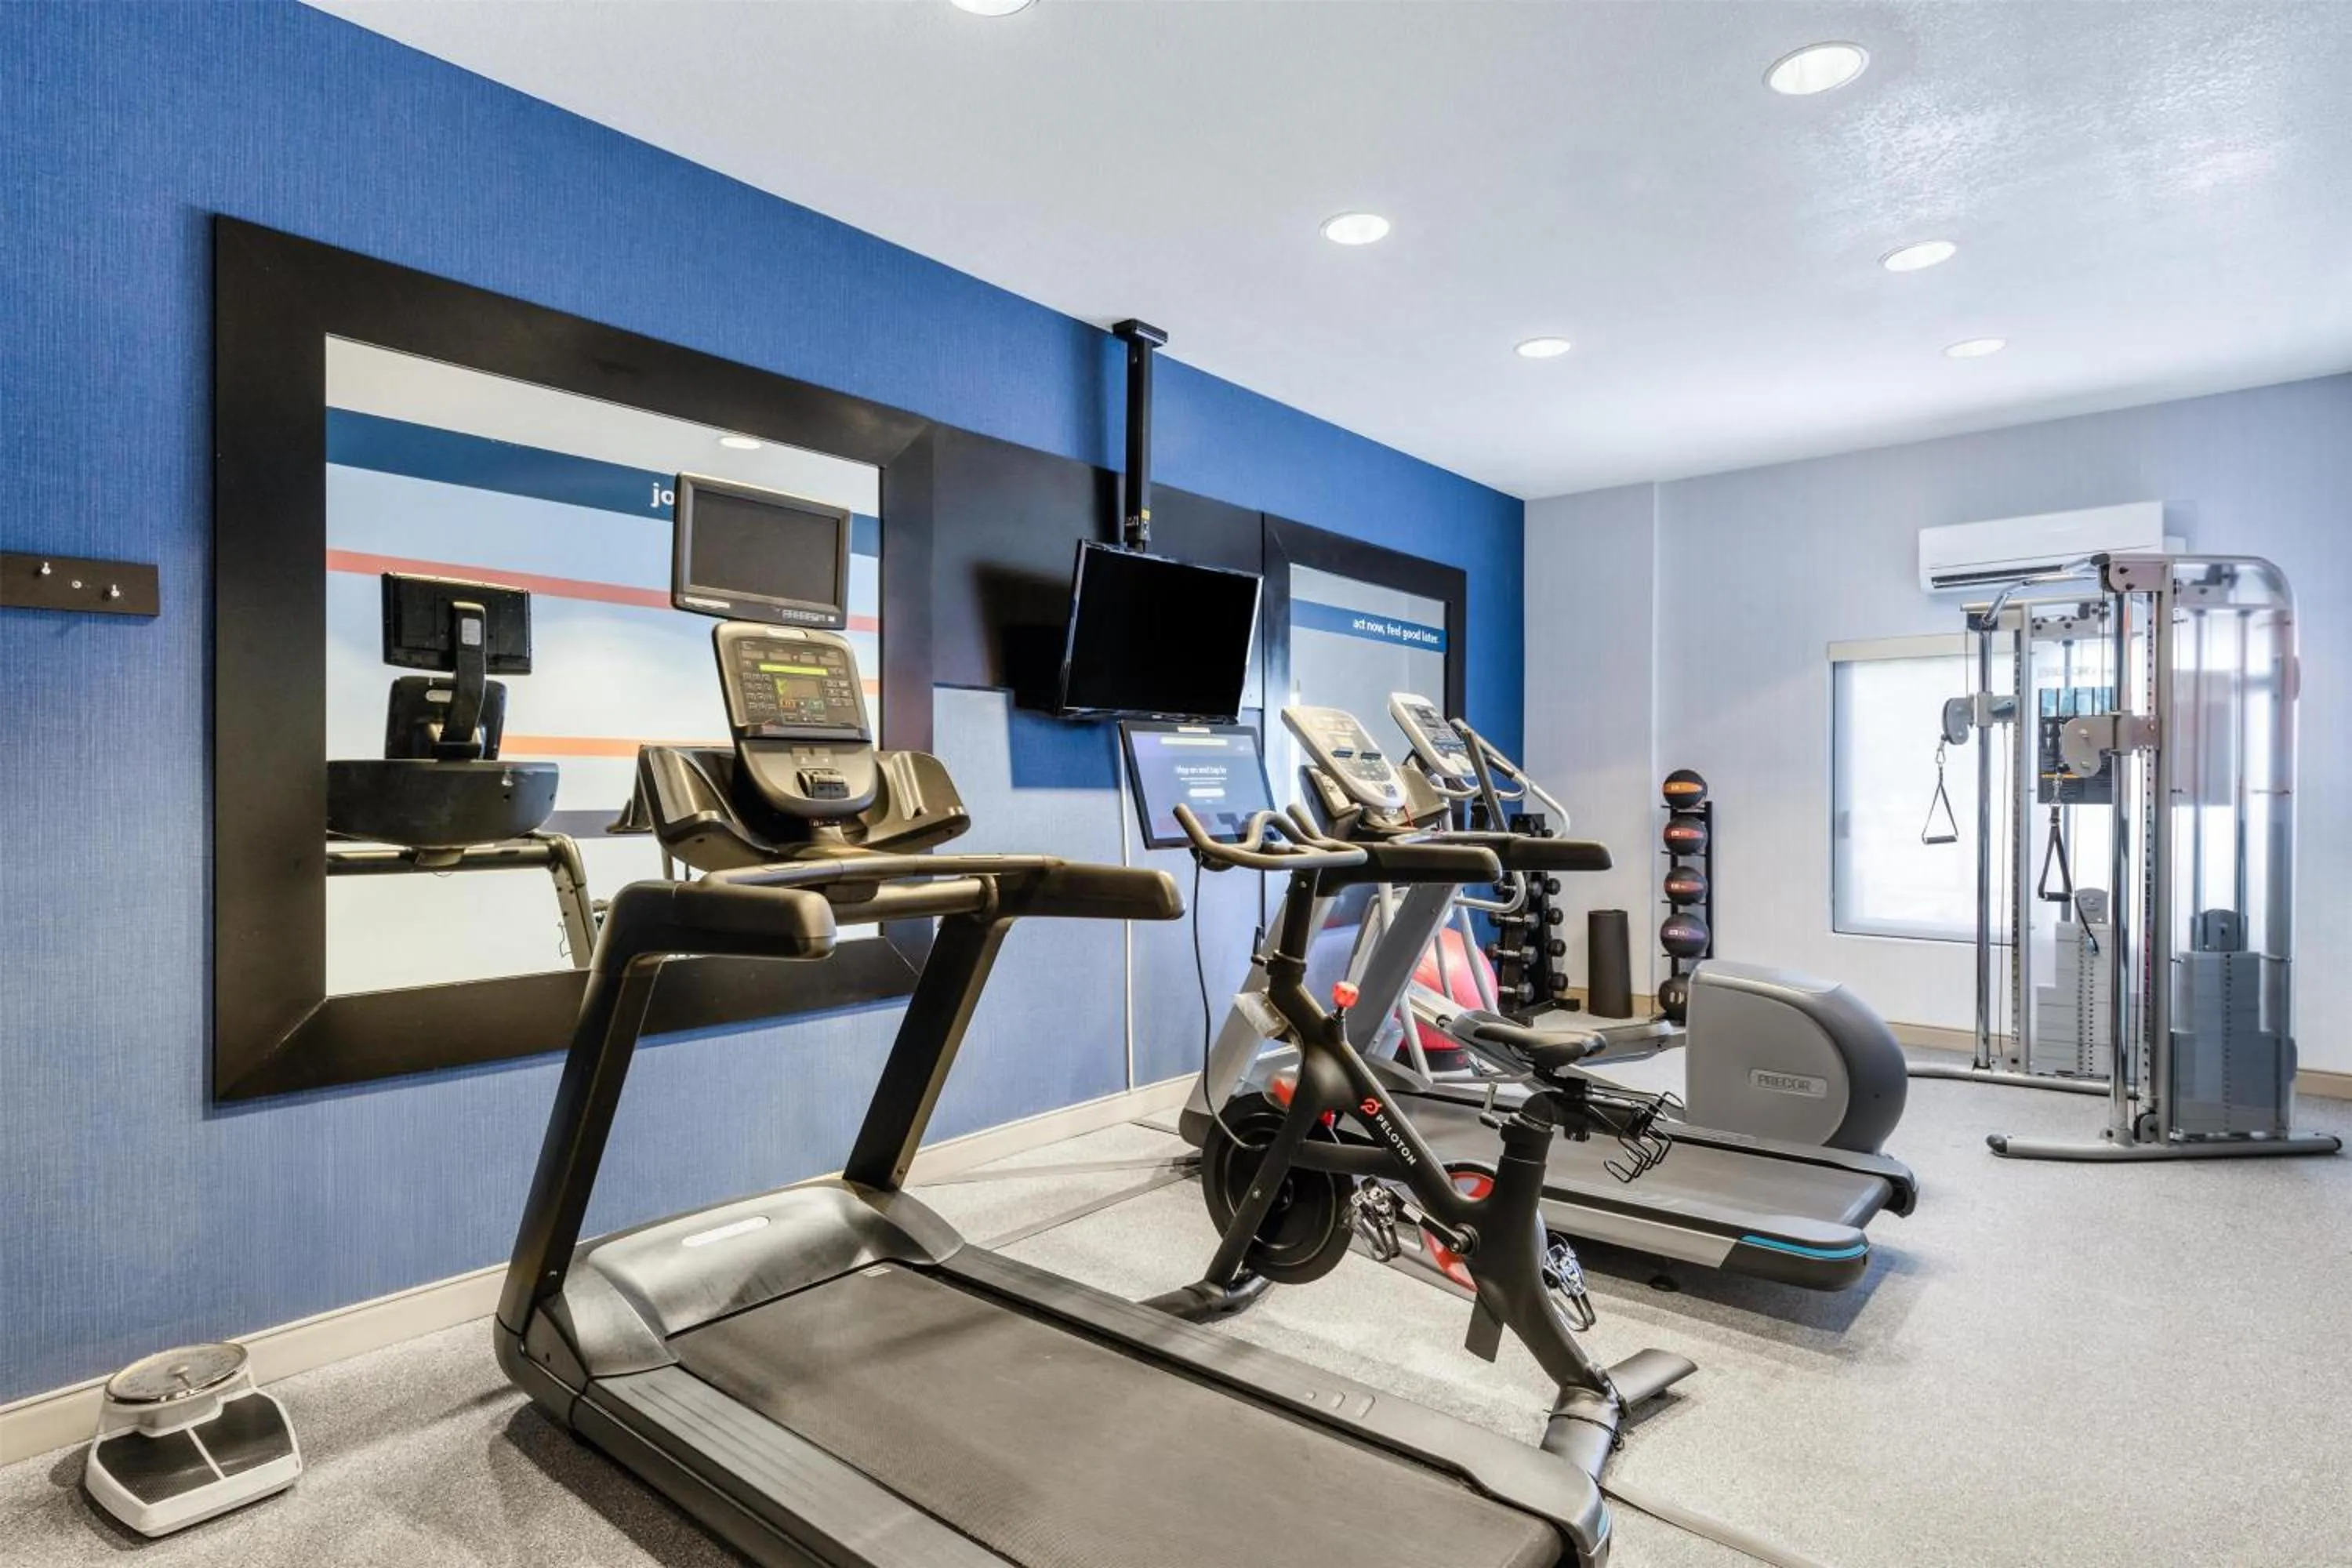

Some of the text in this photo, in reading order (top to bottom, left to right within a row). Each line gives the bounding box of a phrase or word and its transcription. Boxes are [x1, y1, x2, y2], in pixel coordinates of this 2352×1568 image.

[650, 482, 674, 508] jo
[1353, 619, 1365, 630] act
[1387, 623, 1402, 637] feel
[1403, 628, 1421, 641] good
[1758, 1074, 1810, 1092] PRECOR
[1375, 1114, 1417, 1166] PELOTON
